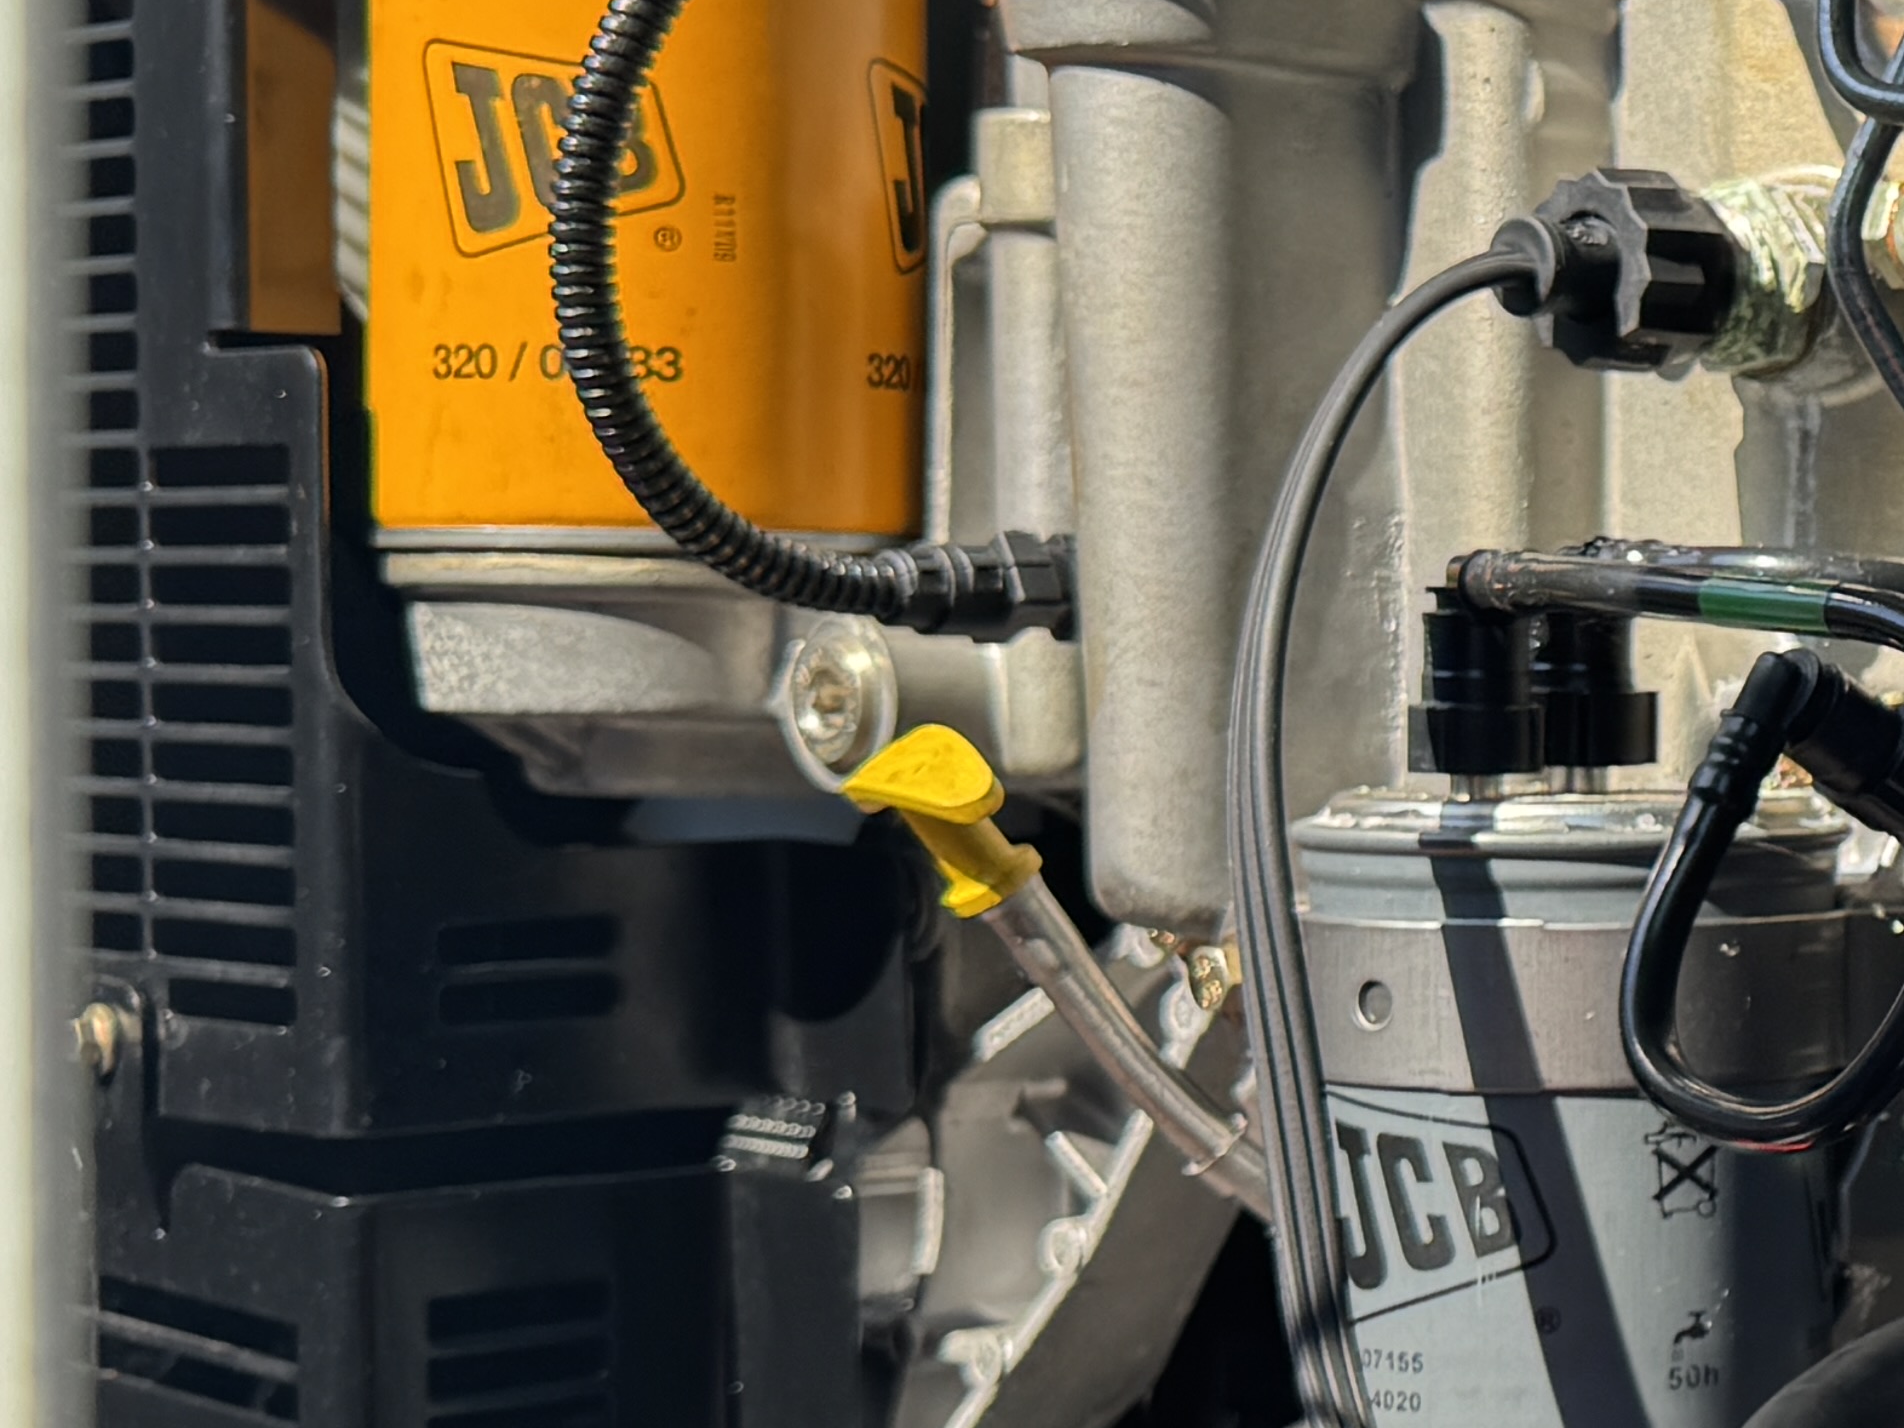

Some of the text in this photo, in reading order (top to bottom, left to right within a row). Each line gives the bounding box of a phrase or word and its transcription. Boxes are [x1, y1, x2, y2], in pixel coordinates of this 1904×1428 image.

[432, 342, 498, 381] 320
[1335, 1118, 1521, 1291] JCB
[1668, 1366, 1719, 1390] 50h
